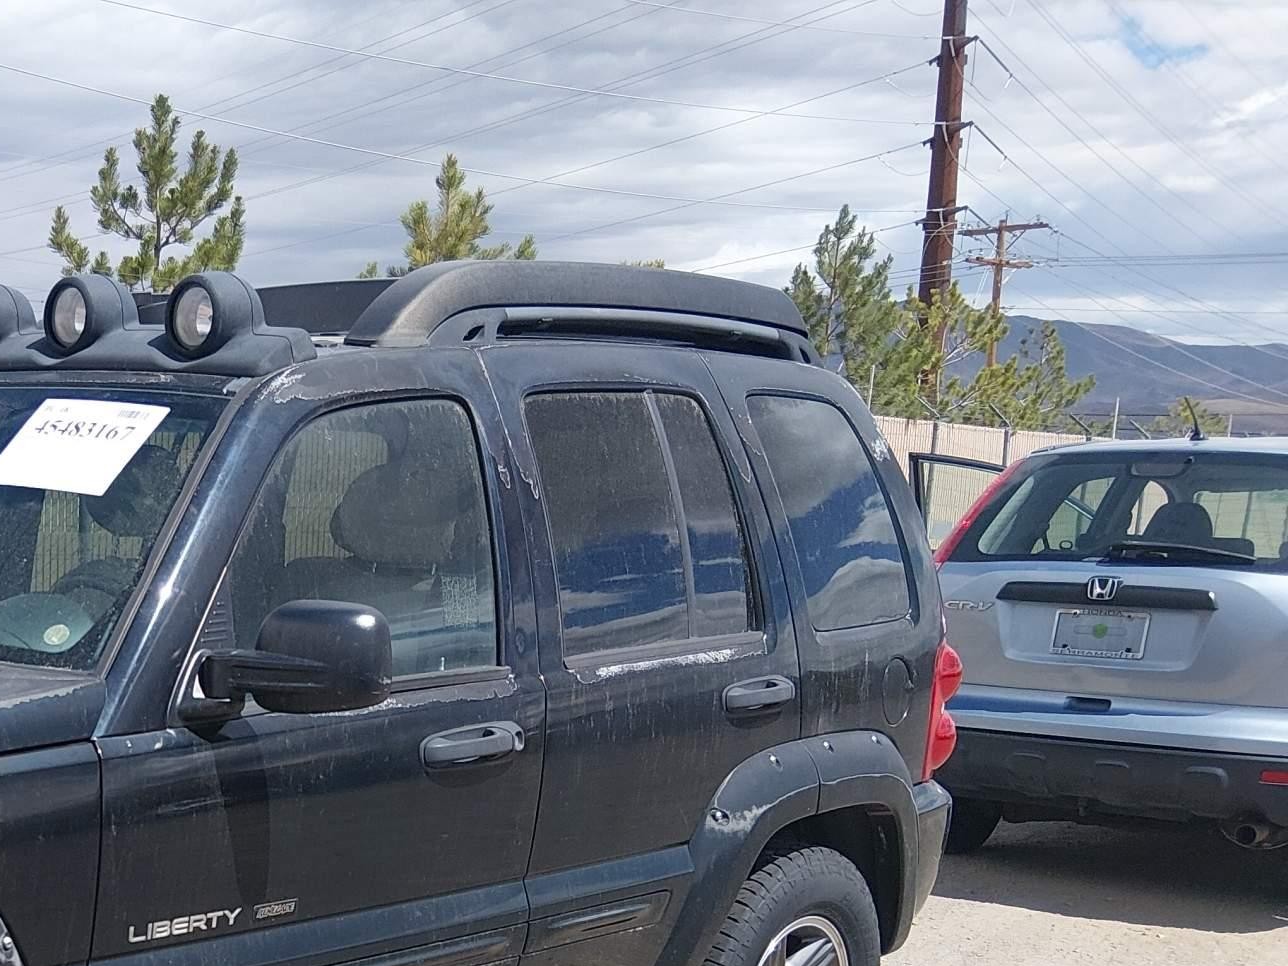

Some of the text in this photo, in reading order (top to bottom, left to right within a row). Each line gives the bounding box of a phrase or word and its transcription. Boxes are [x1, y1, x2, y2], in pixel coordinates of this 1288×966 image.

[35, 419, 137, 441] 45483167
[1078, 607, 1123, 617] HONDA
[128, 907, 243, 943] LIBERTY
